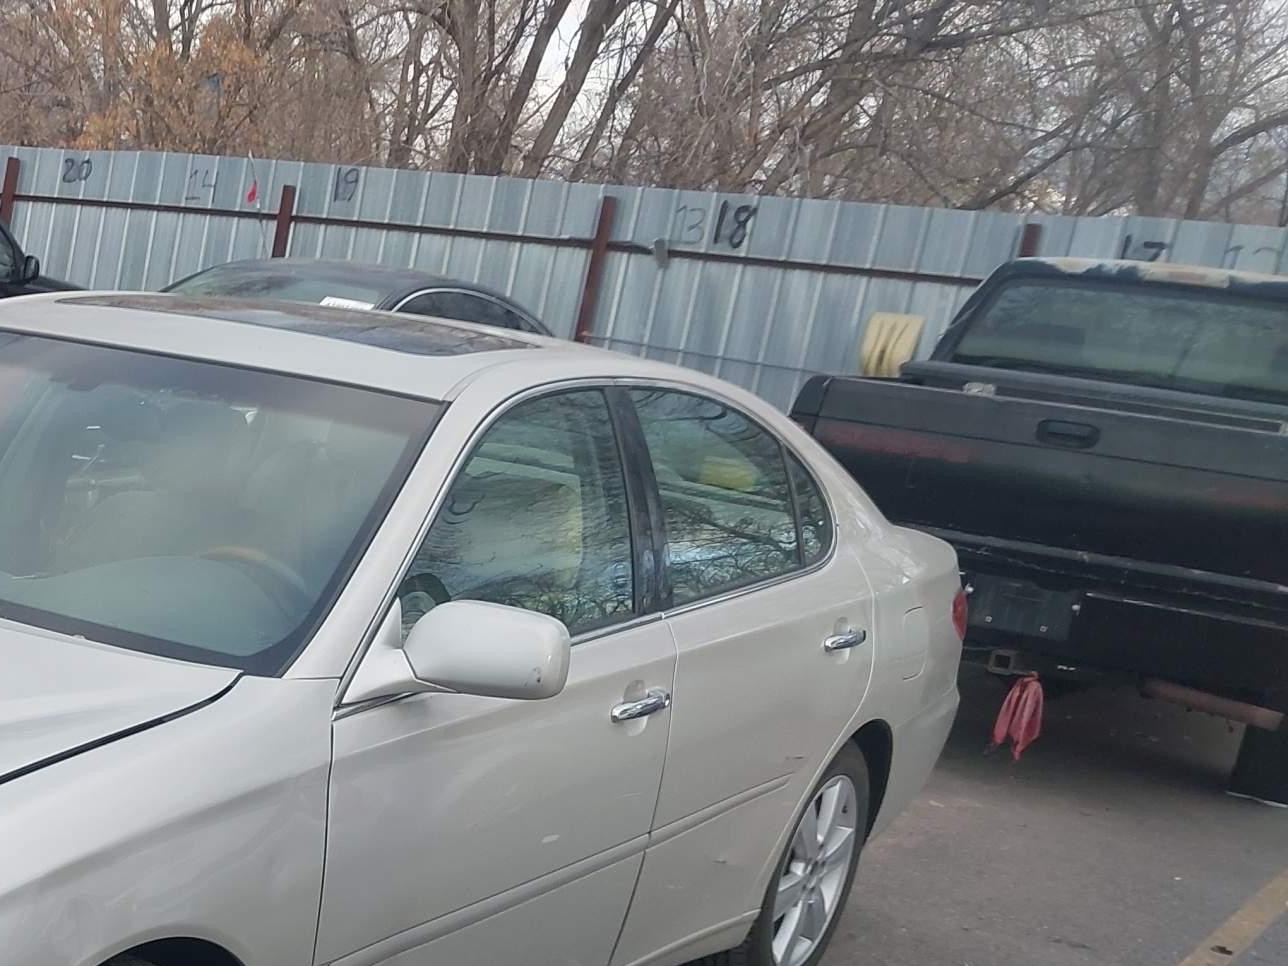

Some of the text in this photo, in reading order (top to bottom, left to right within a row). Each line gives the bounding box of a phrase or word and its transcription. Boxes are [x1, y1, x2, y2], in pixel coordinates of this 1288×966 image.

[62, 158, 93, 183] 20
[333, 167, 360, 203] 19
[713, 199, 759, 249] 18
